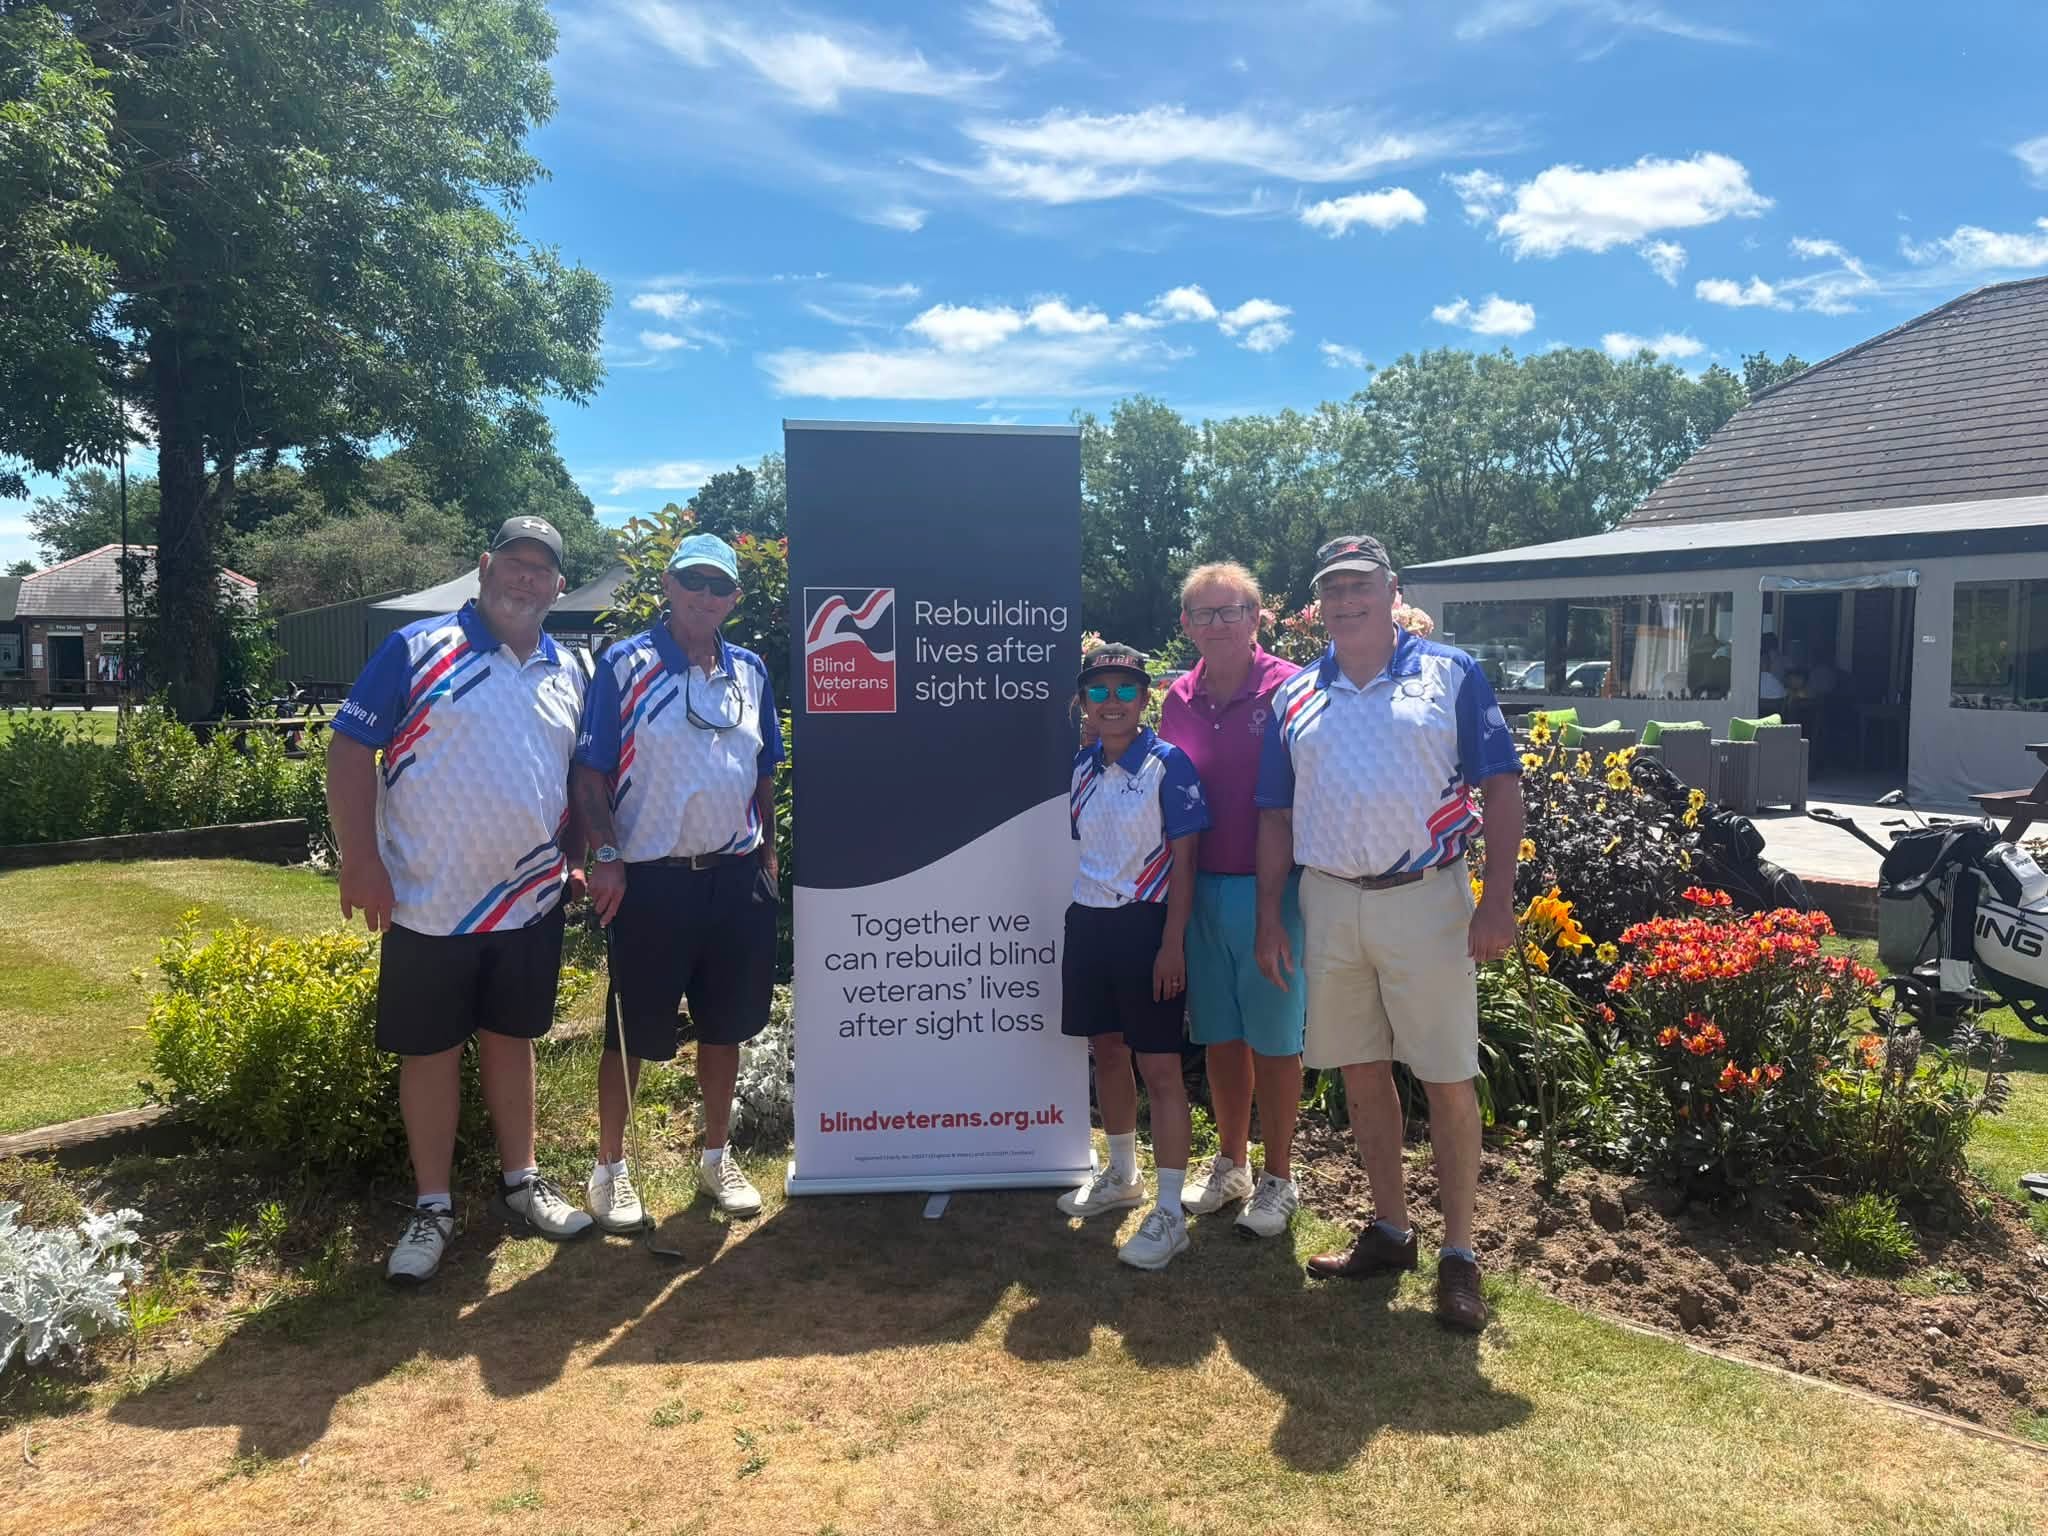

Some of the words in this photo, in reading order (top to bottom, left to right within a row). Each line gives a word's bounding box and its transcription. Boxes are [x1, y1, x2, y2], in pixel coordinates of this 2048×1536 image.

[914, 600, 1068, 632] Rebuilding
[915, 637, 978, 663] lives
[987, 636, 1056, 663] after
[813, 657, 856, 673] Blind
[813, 674, 889, 690] Veterans
[914, 674, 987, 707] sight
[995, 674, 1050, 700] loss
[814, 692, 838, 707] UK
[851, 910, 981, 942] Together
[988, 914, 1031, 933] we
[1975, 915, 2044, 957] ING
[825, 951, 878, 971] can
[886, 942, 982, 969] rebuild
[990, 940, 1056, 967] blind
[980, 975, 1040, 999] lives
[839, 1013, 908, 1038] after
[915, 1010, 984, 1041] sight
[992, 1008, 1045, 1033] loss
[820, 1103, 1065, 1133] blindveterans.org.uk
